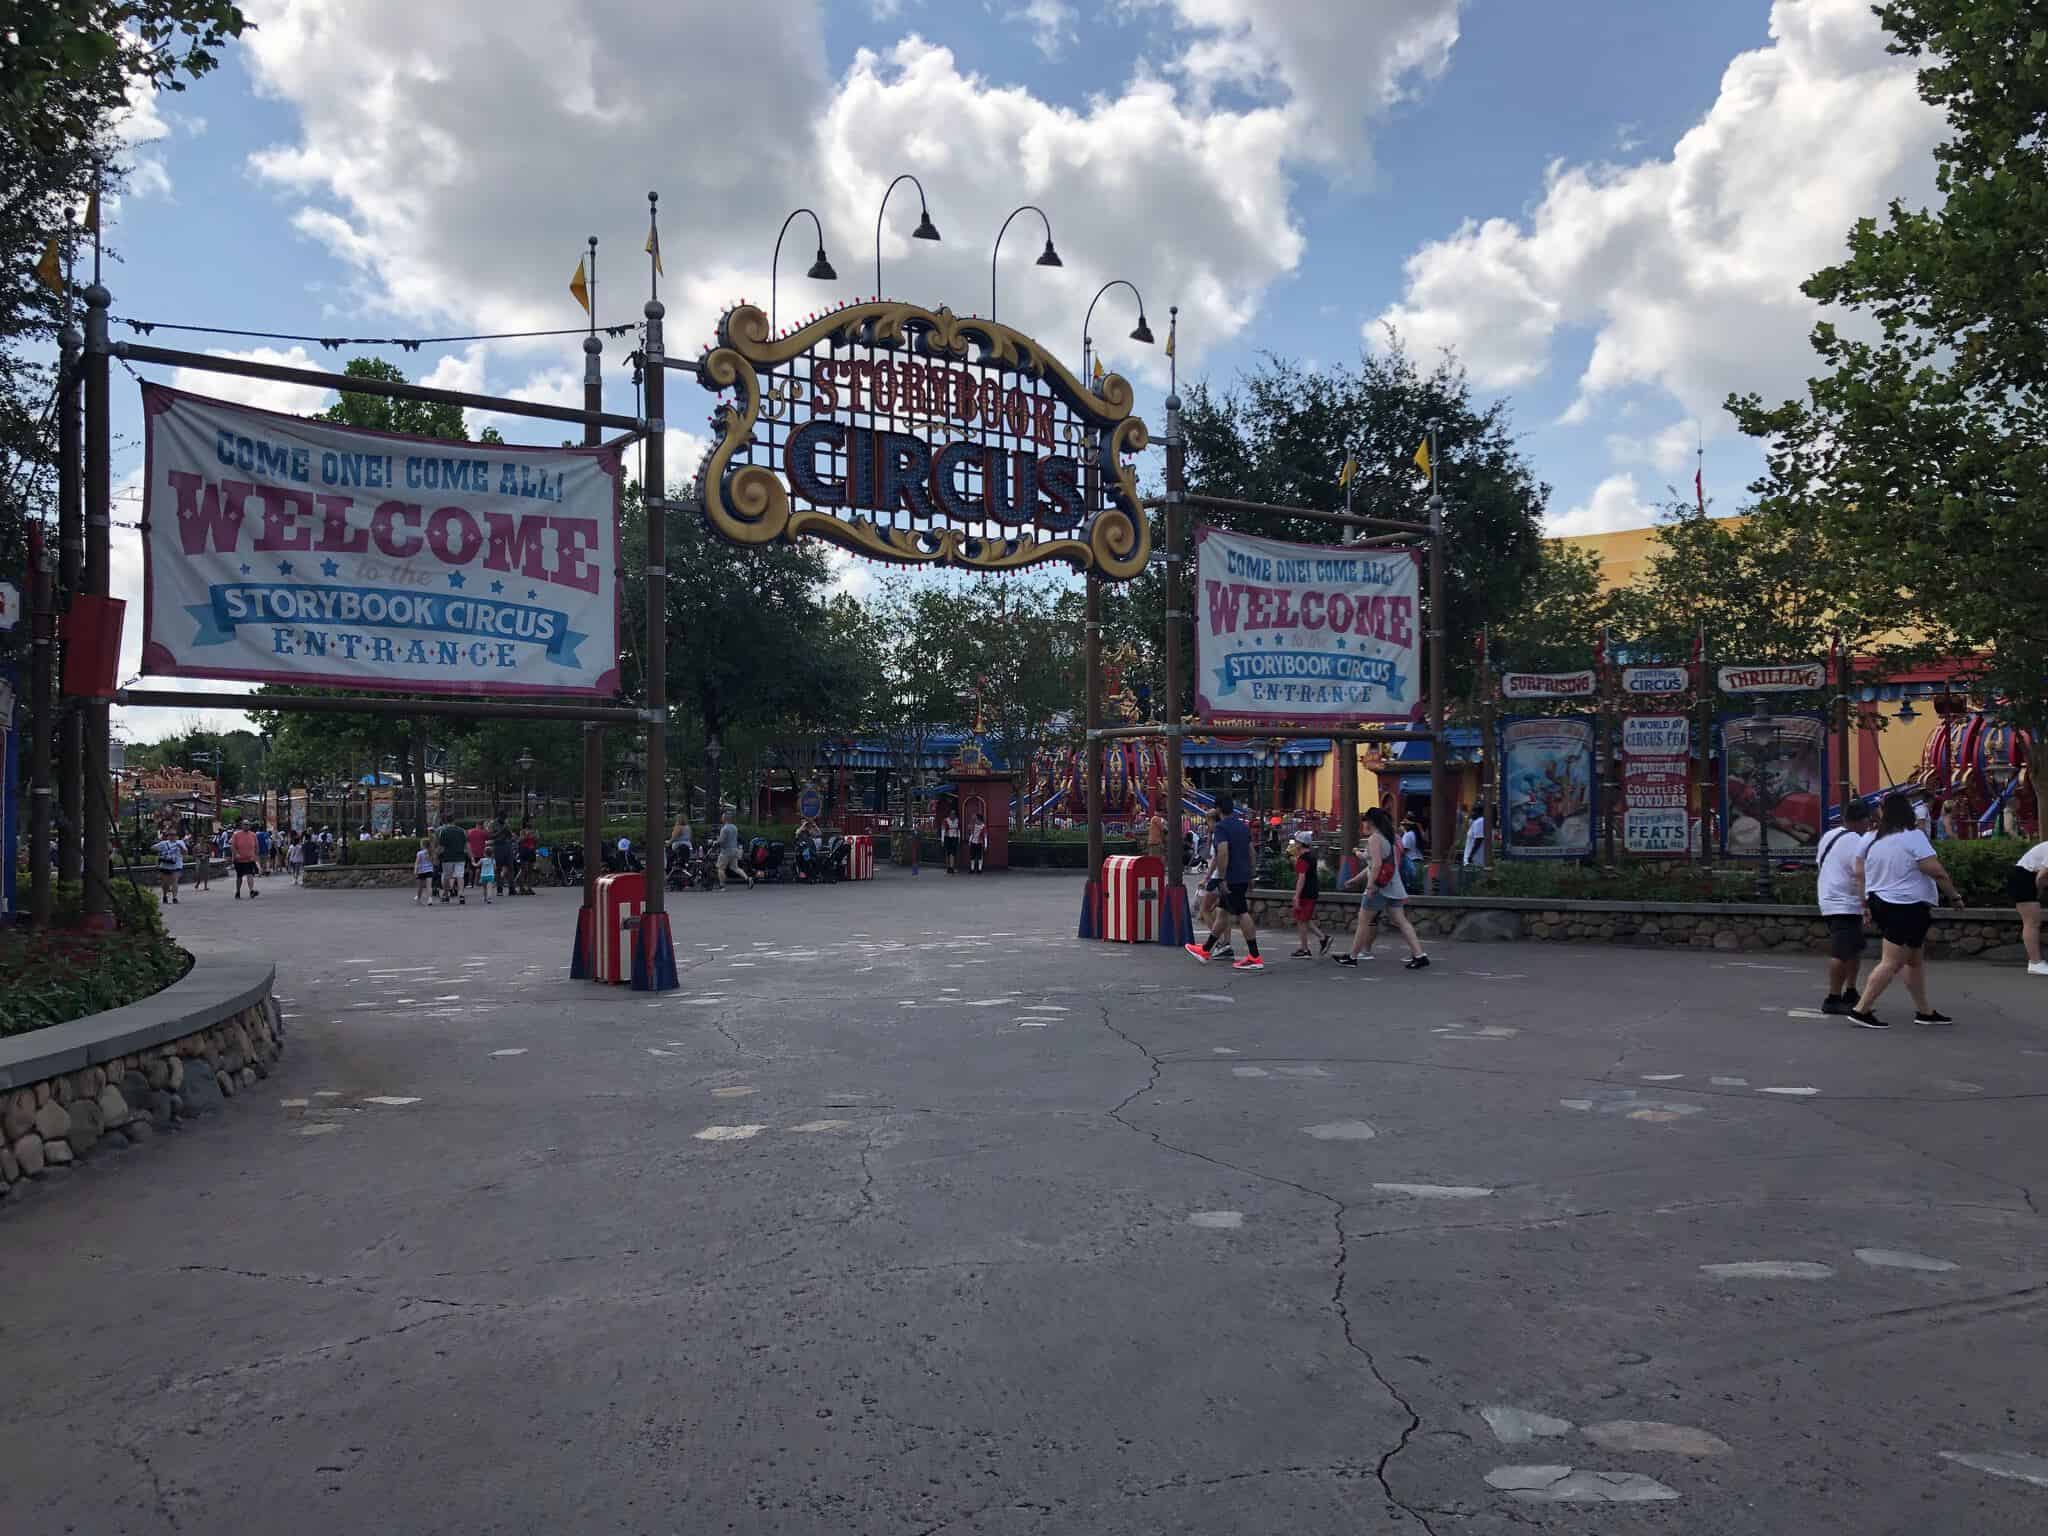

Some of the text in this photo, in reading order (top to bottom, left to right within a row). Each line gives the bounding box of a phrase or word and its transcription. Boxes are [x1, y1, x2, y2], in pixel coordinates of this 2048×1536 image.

[813, 359, 1056, 450] STORYBOOK
[216, 430, 564, 502] COME ONE! COME ALL!
[784, 420, 1088, 531] CIRCUS
[168, 470, 600, 594] WELCOME
[355, 559, 432, 585] to the
[1227, 550, 1271, 582] COME
[1277, 559, 1311, 584] ONE!
[1316, 560, 1358, 583] COME
[224, 588, 554, 639] STORYBOOK CIRCUS
[1206, 580, 1413, 649] WELCOME
[1231, 655, 1390, 682] STORYBOOK CIRCUS
[1726, 669, 1817, 689] THRILLING
[1510, 675, 1590, 692] SURPRISING
[1630, 680, 1682, 691] CIRCUS
[1638, 720, 1669, 729] WORLD
[1626, 732, 1664, 746] CIRCUS
[1627, 784, 1685, 794] COUNTLESS
[1625, 795, 1687, 807] WONDERS
[1629, 826, 1685, 839] FEATS
[1646, 839, 1667, 849] ALL
